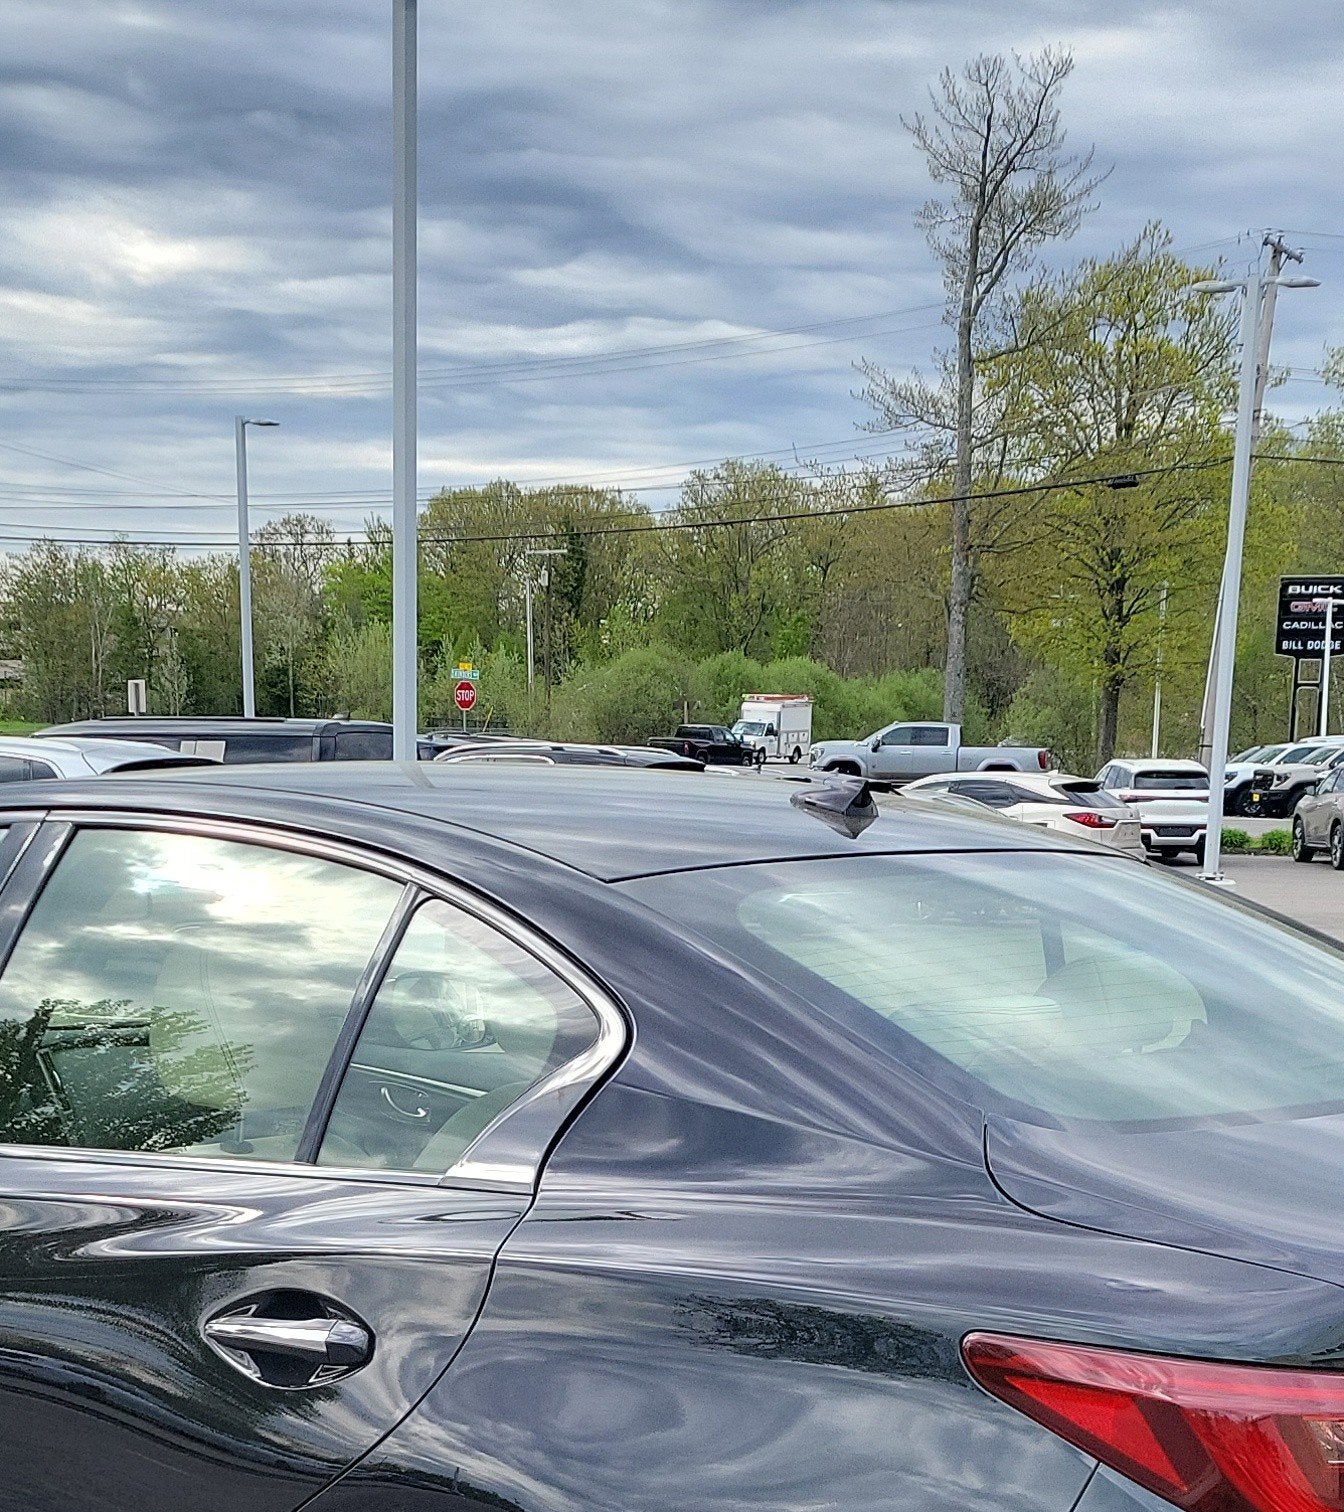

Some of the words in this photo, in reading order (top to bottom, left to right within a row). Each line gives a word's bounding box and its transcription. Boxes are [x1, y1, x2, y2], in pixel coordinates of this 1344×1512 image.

[1288, 585, 1343, 594] BUICK
[1290, 601, 1338, 612] GM
[1282, 640, 1303, 650] BILL
[456, 689, 475, 701] STOP
